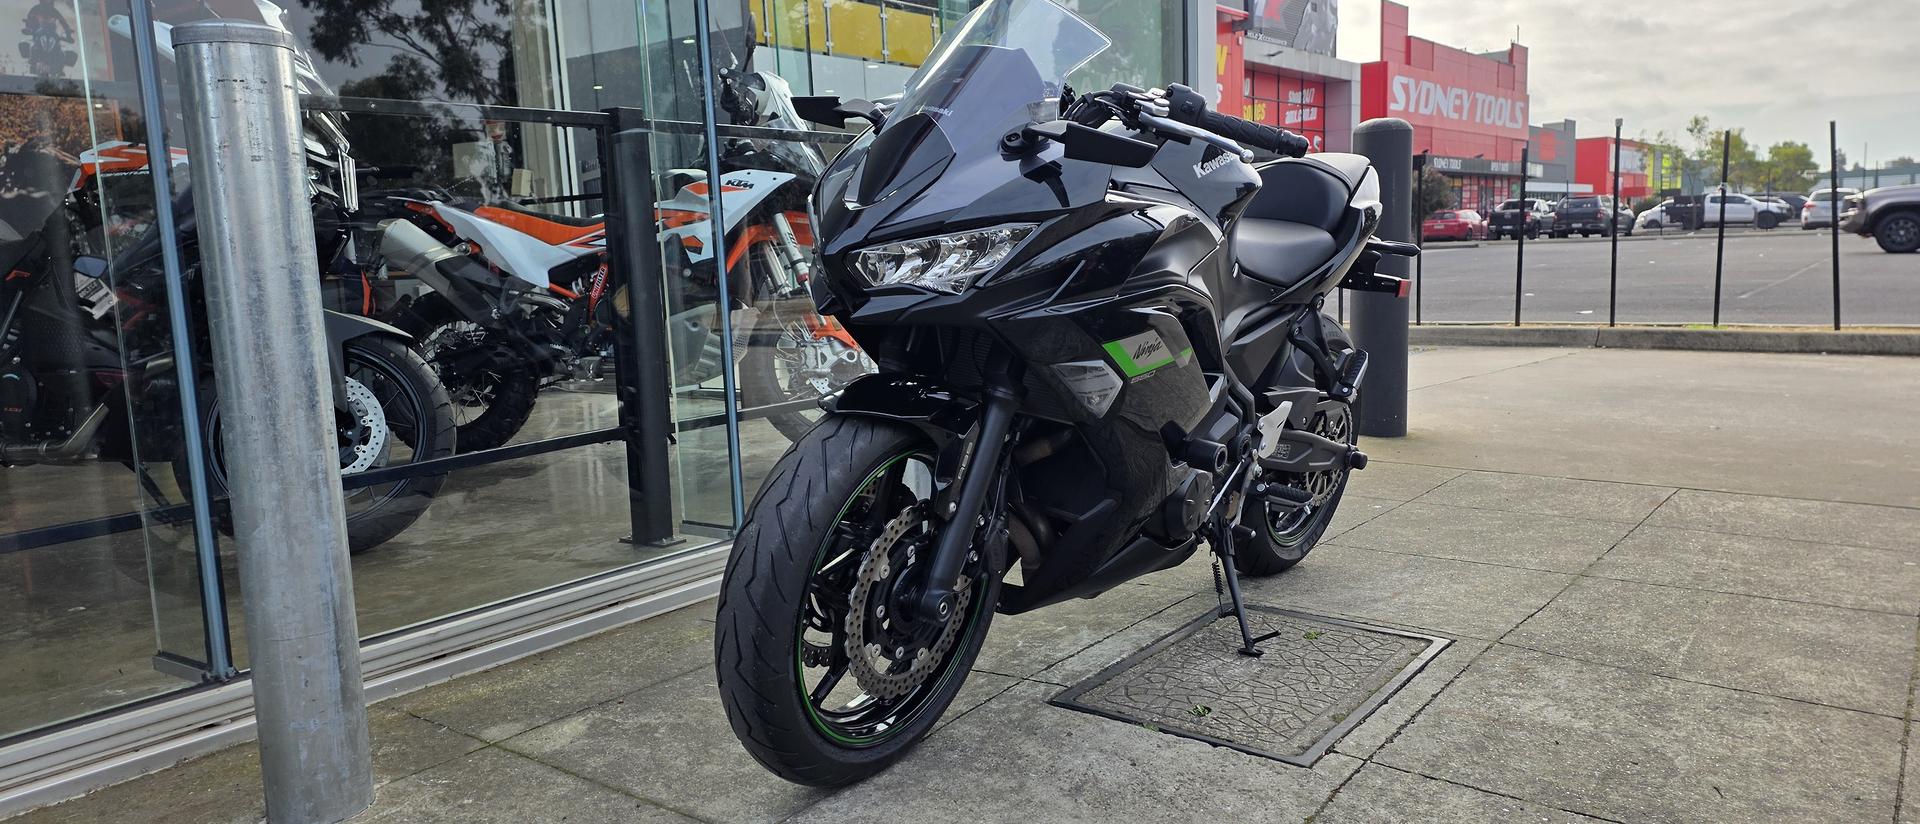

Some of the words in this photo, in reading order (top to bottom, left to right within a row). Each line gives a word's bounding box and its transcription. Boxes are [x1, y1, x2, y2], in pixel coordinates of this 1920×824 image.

[1389, 75, 1474, 120] SYDNEY
[1475, 92, 1524, 129] TOOLS
[1449, 158, 1462, 169] TOOLS
[725, 179, 755, 189] KTM
[1132, 337, 1162, 359] Ninja
